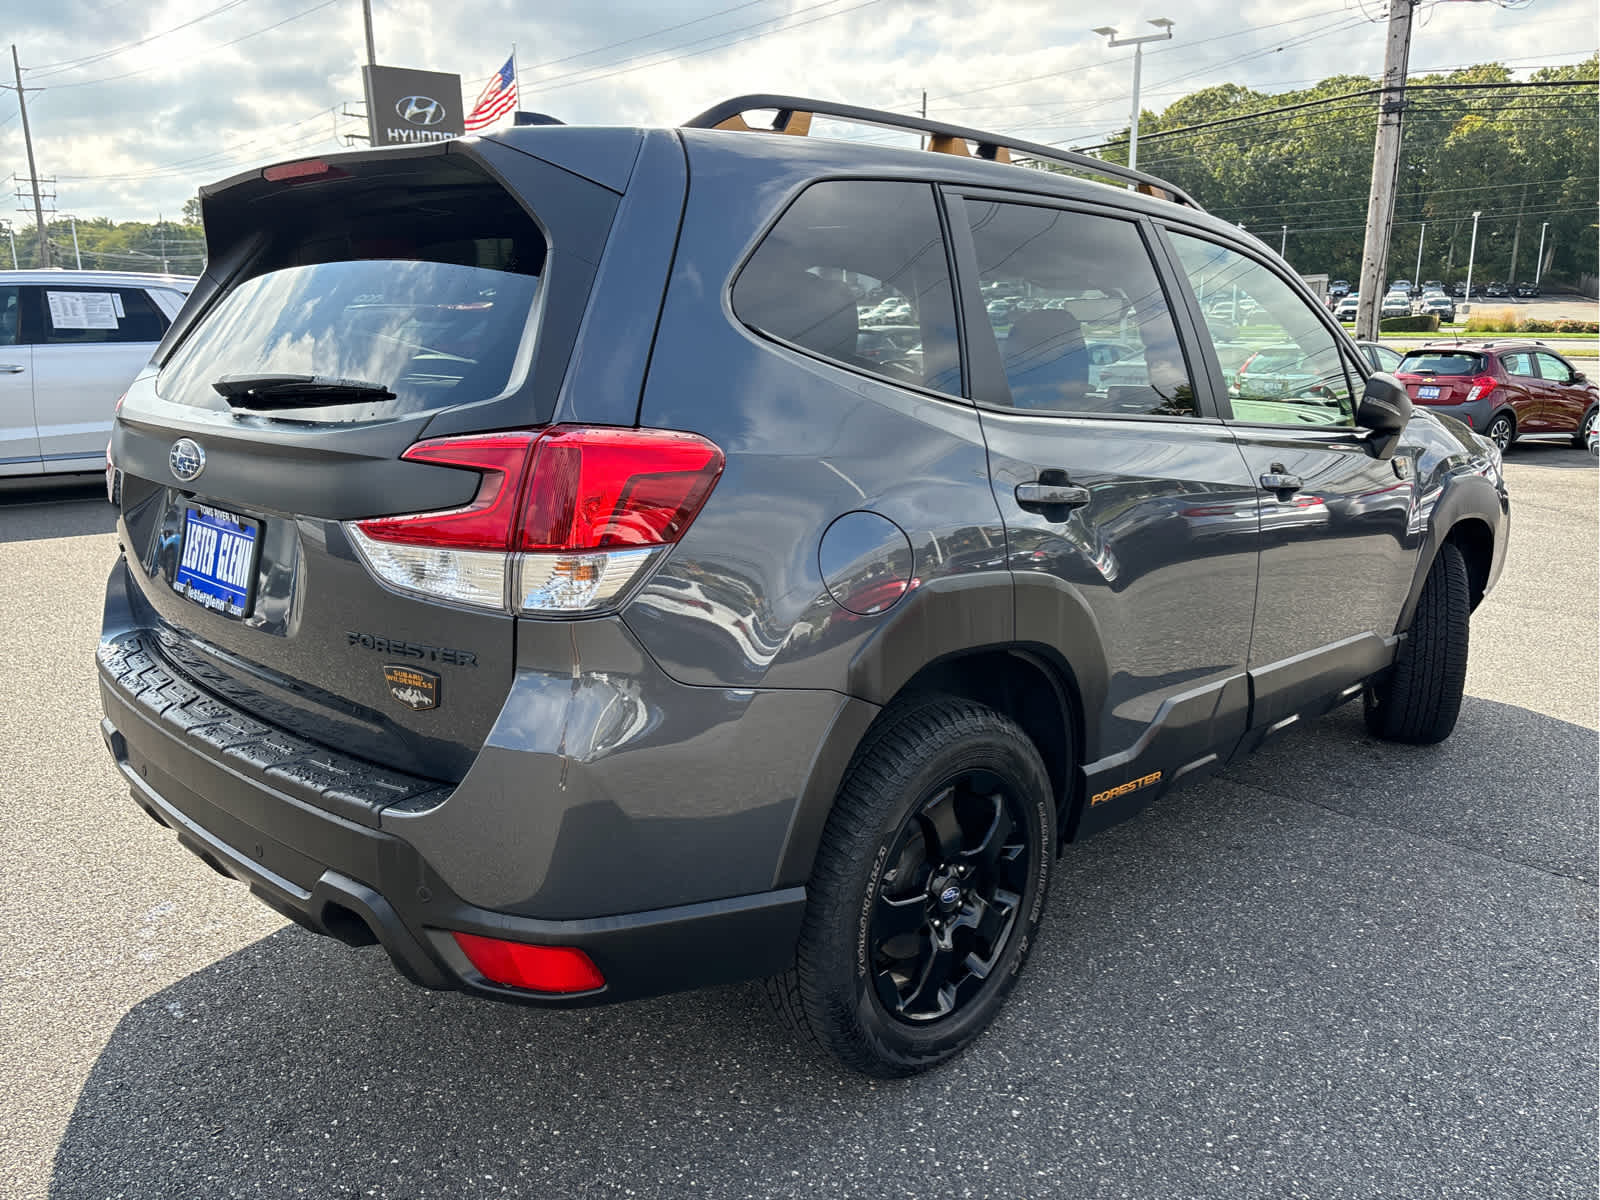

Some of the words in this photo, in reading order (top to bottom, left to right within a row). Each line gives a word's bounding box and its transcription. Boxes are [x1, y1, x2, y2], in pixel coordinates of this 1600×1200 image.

[182, 522, 218, 577] LESTER
[216, 533, 254, 589] GLENN
[345, 631, 479, 667] FORESTER
[386, 674, 433, 689] WILDERNESS
[393, 669, 423, 682] SUBARU
[1091, 770, 1162, 808] FORESTER
